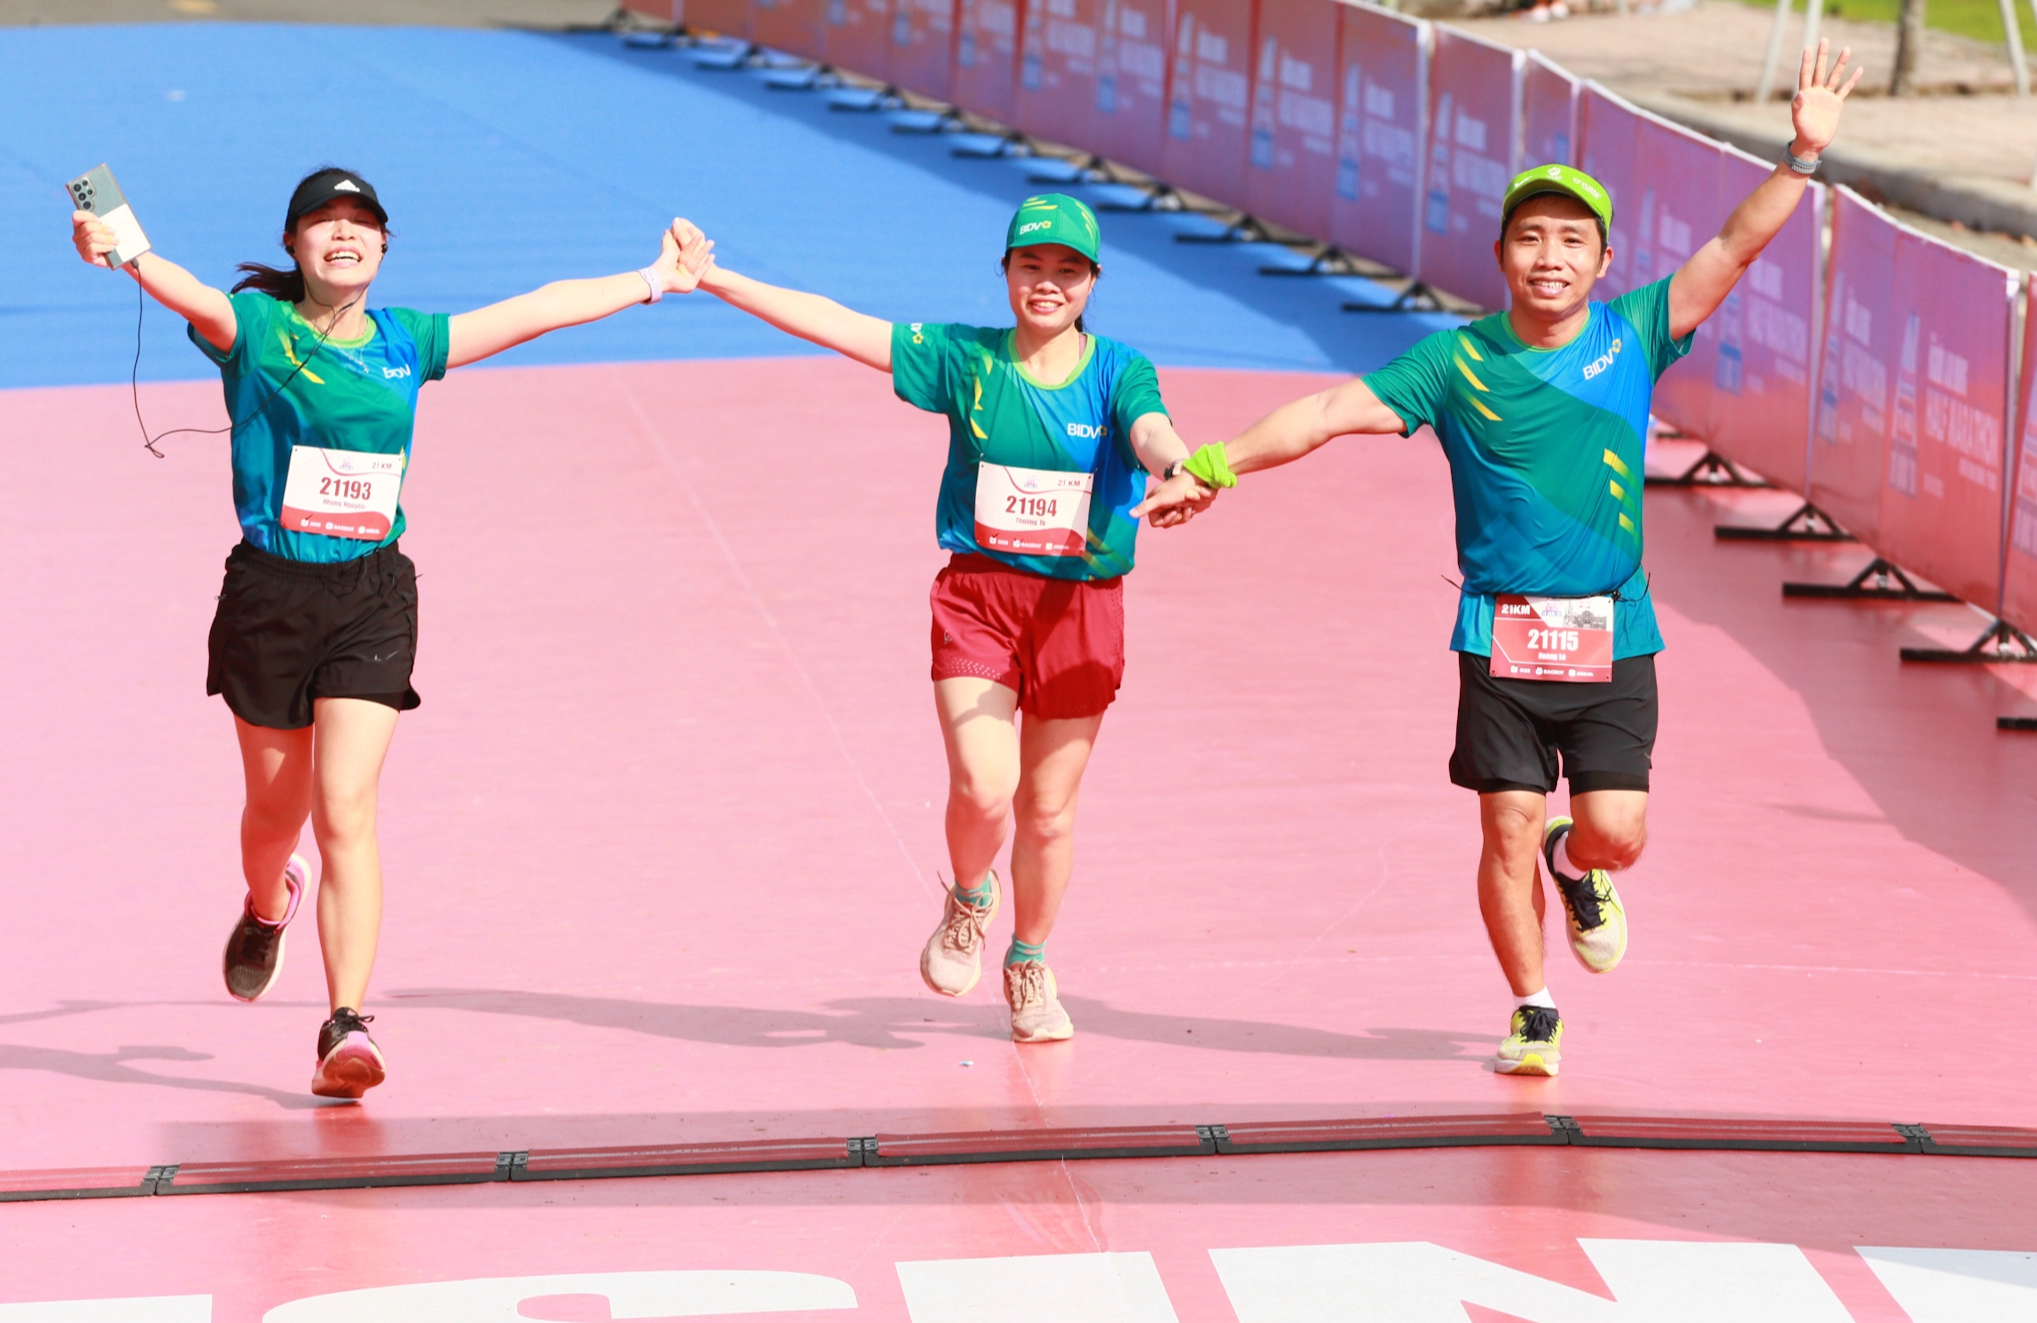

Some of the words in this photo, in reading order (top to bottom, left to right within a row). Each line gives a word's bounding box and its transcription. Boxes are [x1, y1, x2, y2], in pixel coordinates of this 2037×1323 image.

[1019, 222, 1042, 235] BIDV
[1582, 348, 1614, 380] BIDV
[1067, 422, 1101, 439] BIDV
[372, 461, 380, 470] 21
[381, 461, 393, 470] KM
[319, 476, 372, 500] 21193
[1057, 479, 1066, 487] 21
[1005, 495, 1058, 517] 21194
[1501, 603, 1531, 615] 21KM
[1527, 628, 1579, 651] 21115
